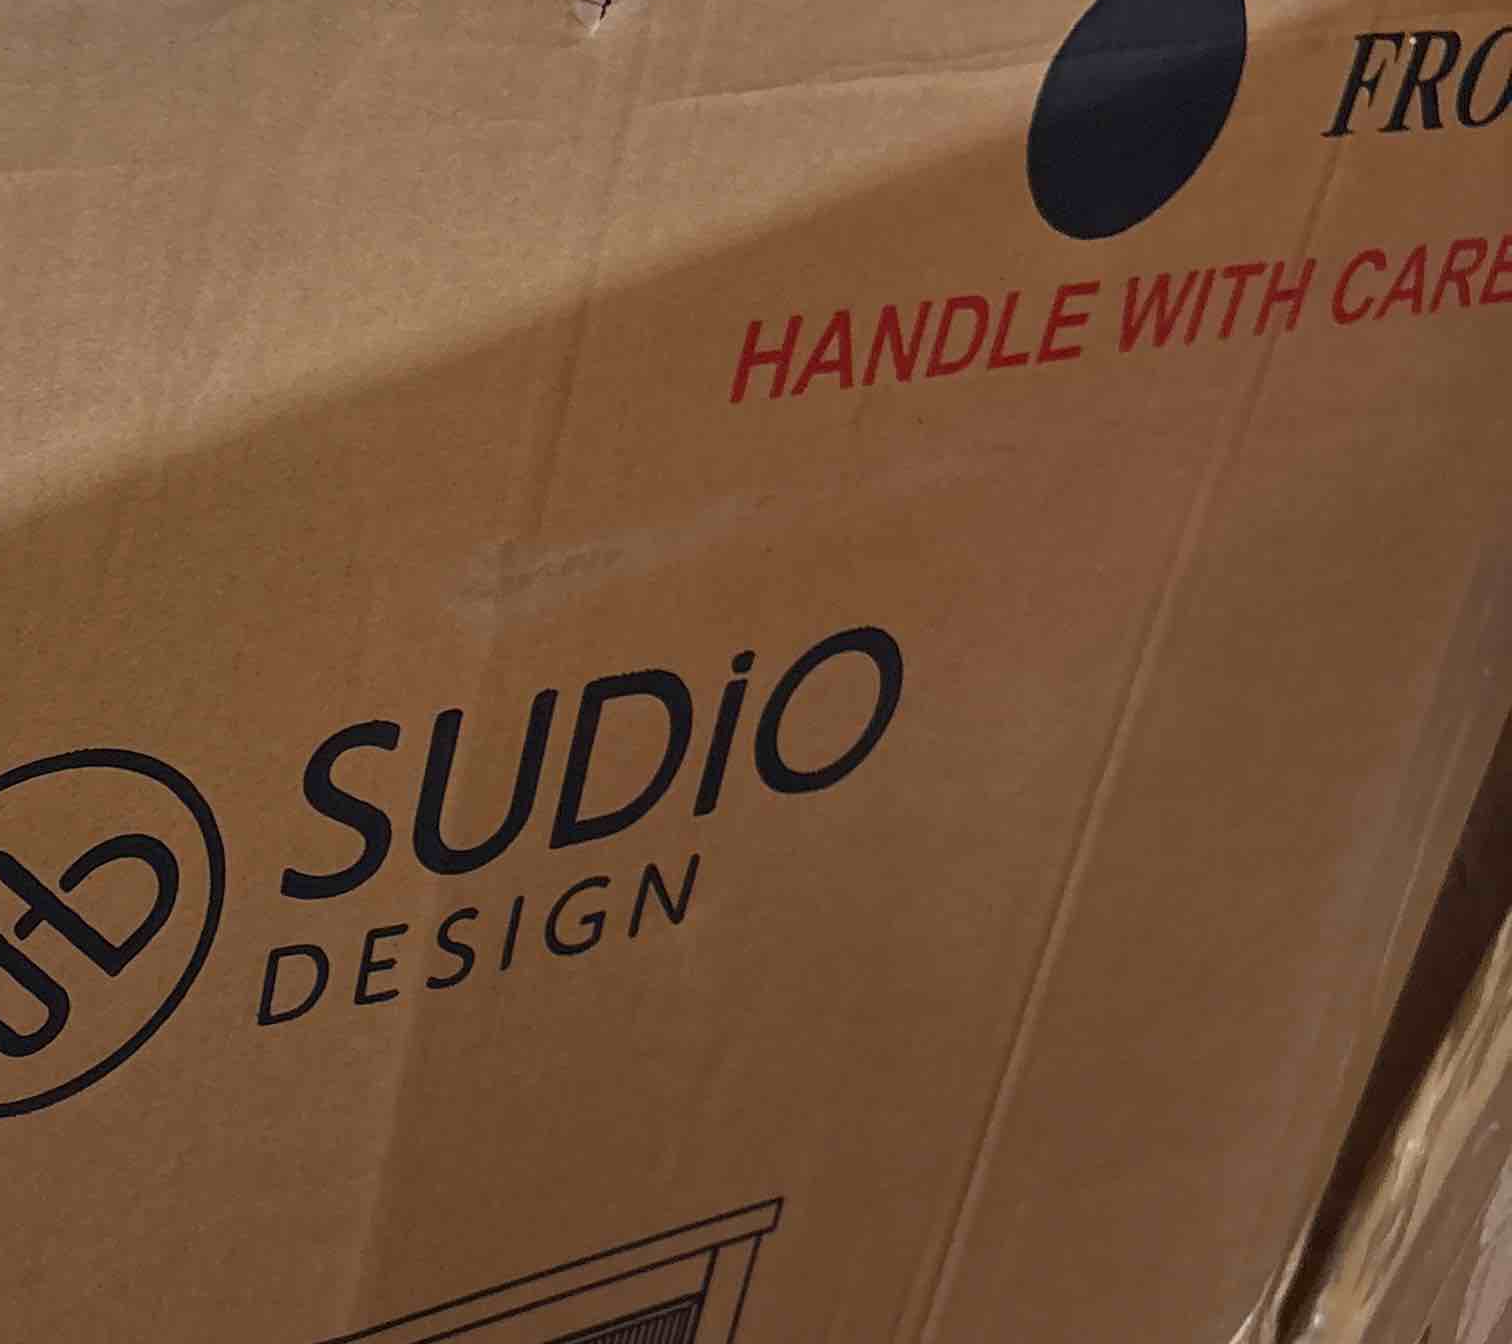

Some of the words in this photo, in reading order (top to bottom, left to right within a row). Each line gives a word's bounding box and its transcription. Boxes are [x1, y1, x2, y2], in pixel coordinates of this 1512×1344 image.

[728, 281, 1099, 404] HANDLE
[1116, 259, 1316, 354] WITH
[1330, 234, 1512, 322] CARE
[256, 854, 700, 1026] DESIGN
